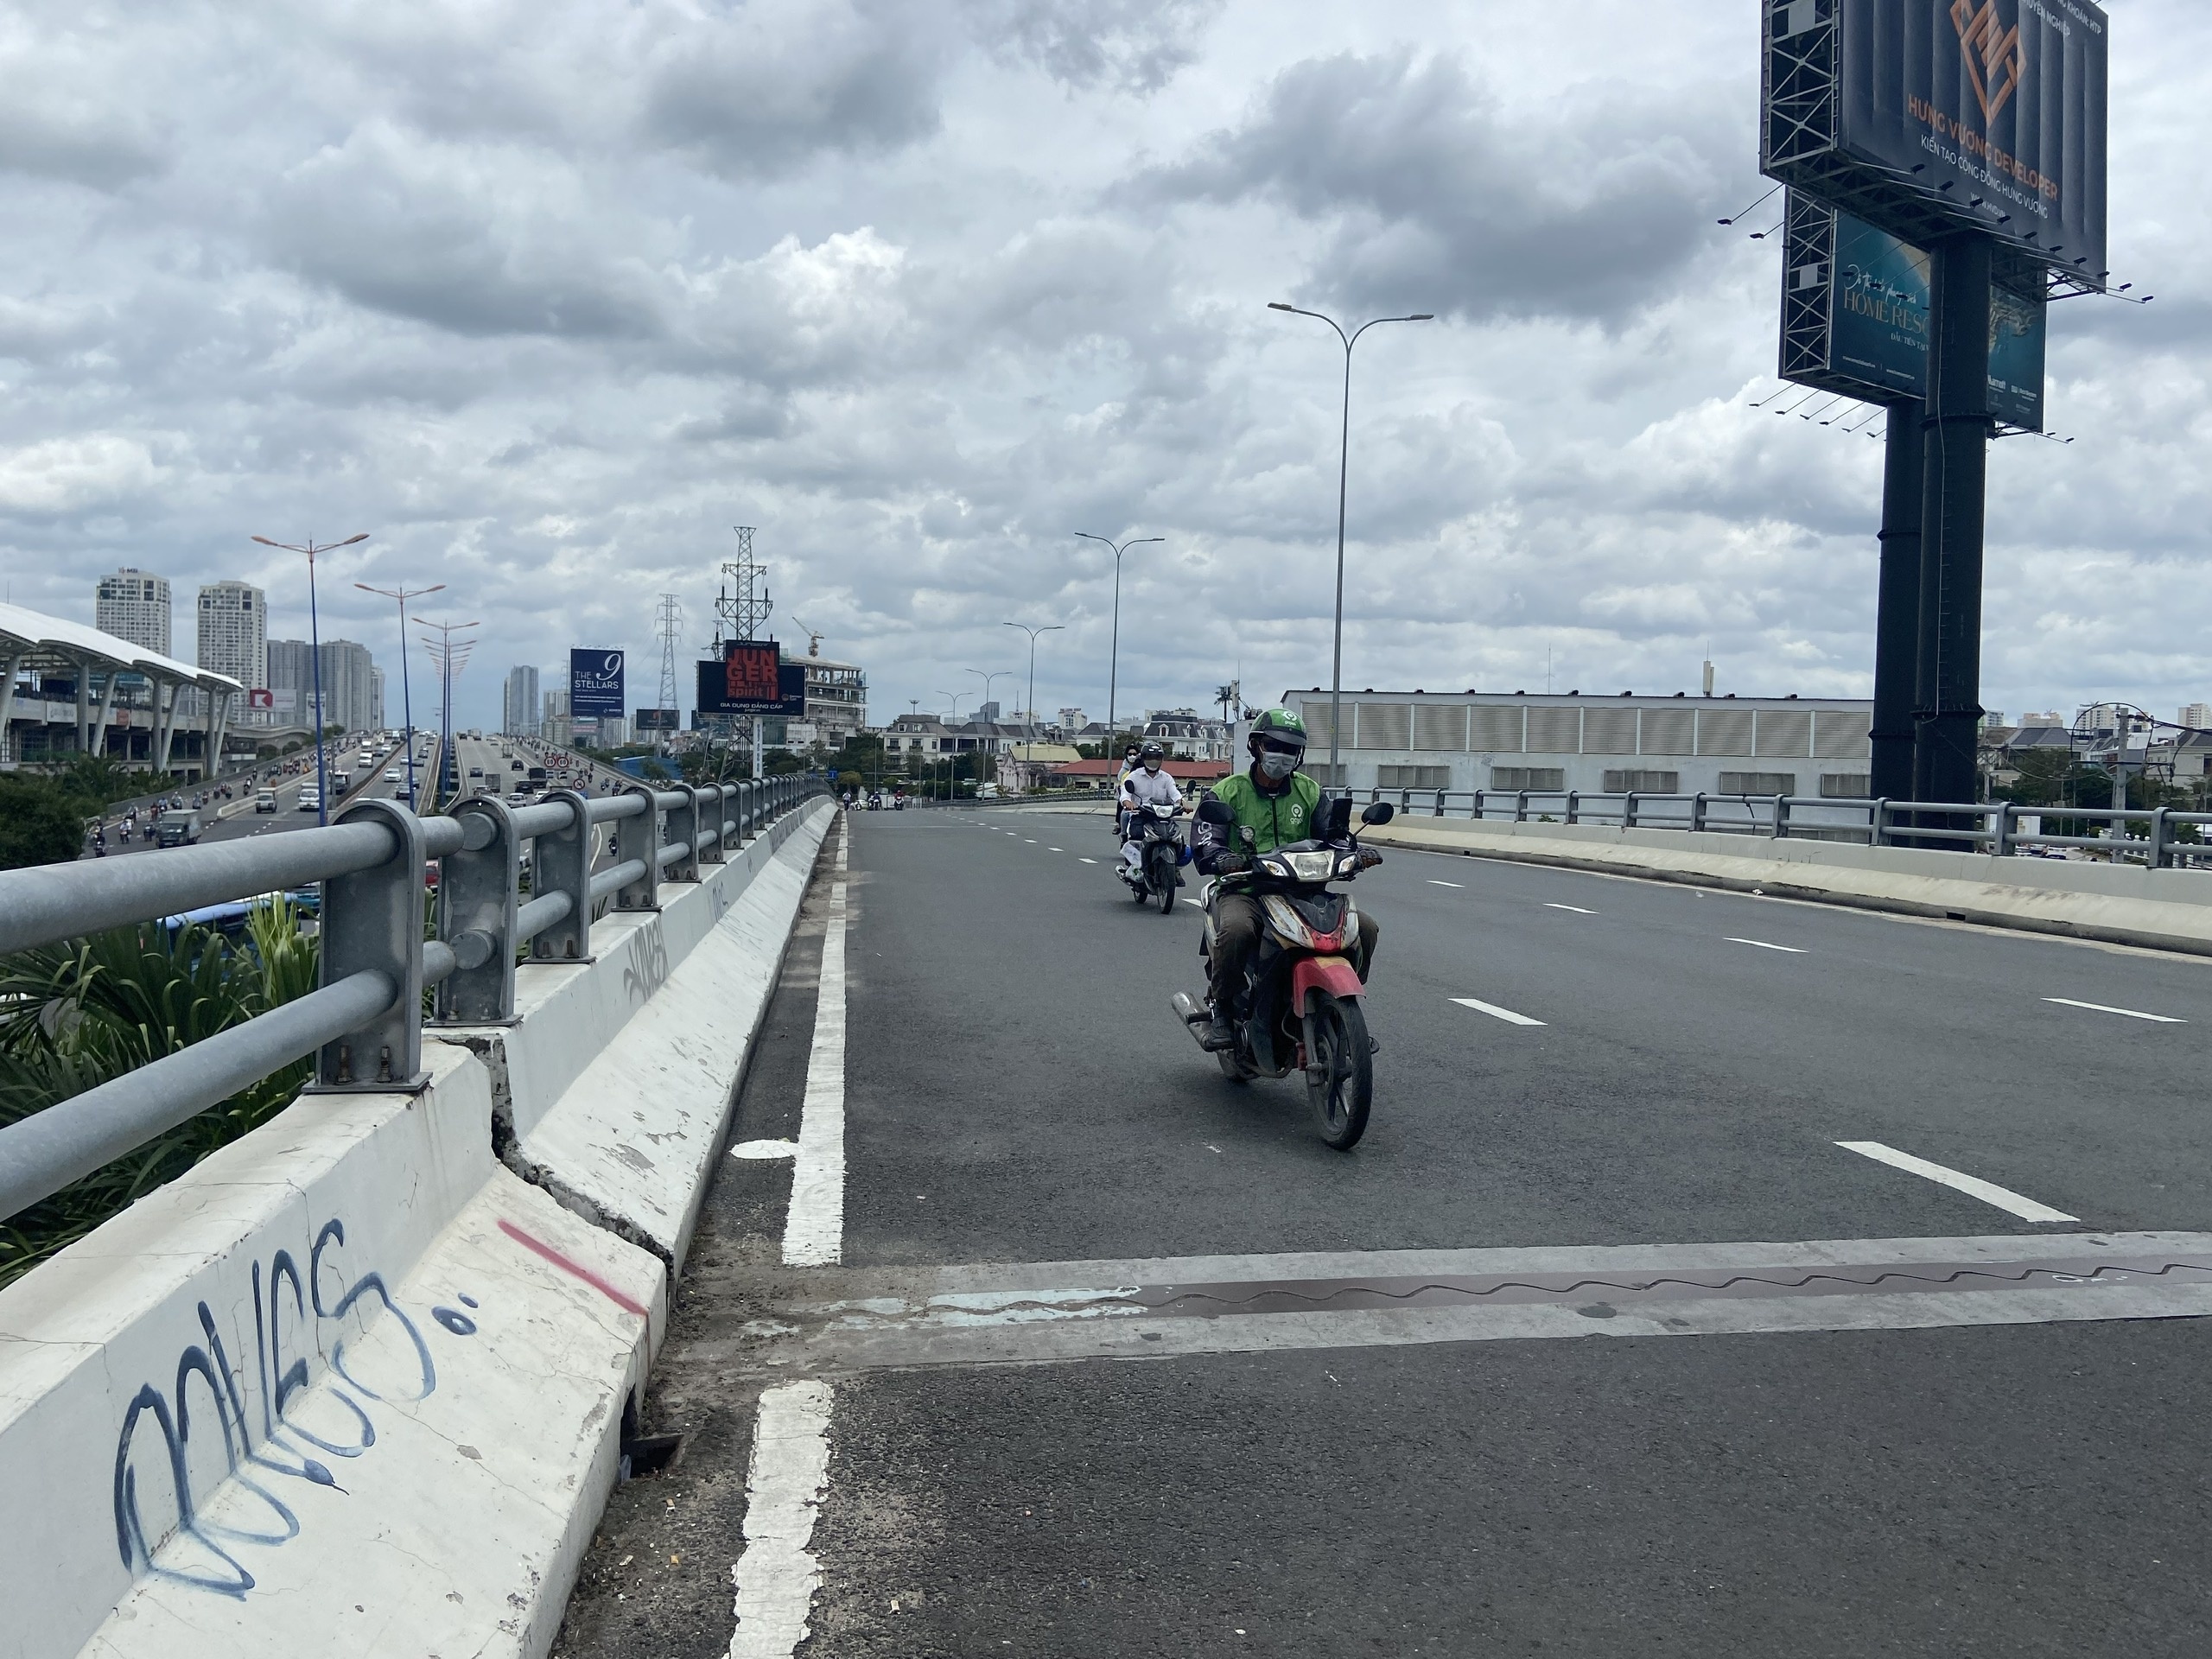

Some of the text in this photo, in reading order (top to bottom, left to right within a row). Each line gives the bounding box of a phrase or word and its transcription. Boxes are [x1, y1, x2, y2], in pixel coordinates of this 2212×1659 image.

[2089, 20, 2102, 35] HTP
[1908, 92, 2058, 201] HƯNG VƯỢNG DEVELOPER
[1921, 133, 2048, 219] KIẾN TẠO CỘNG ĐỒNG HƯNG VƯỢNG
[1844, 289, 1889, 323] HOME
[575, 653, 622, 681] THE 9
[728, 648, 775, 666] JUN
[575, 679, 620, 690] STELLARS
[727, 664, 778, 683] GER
